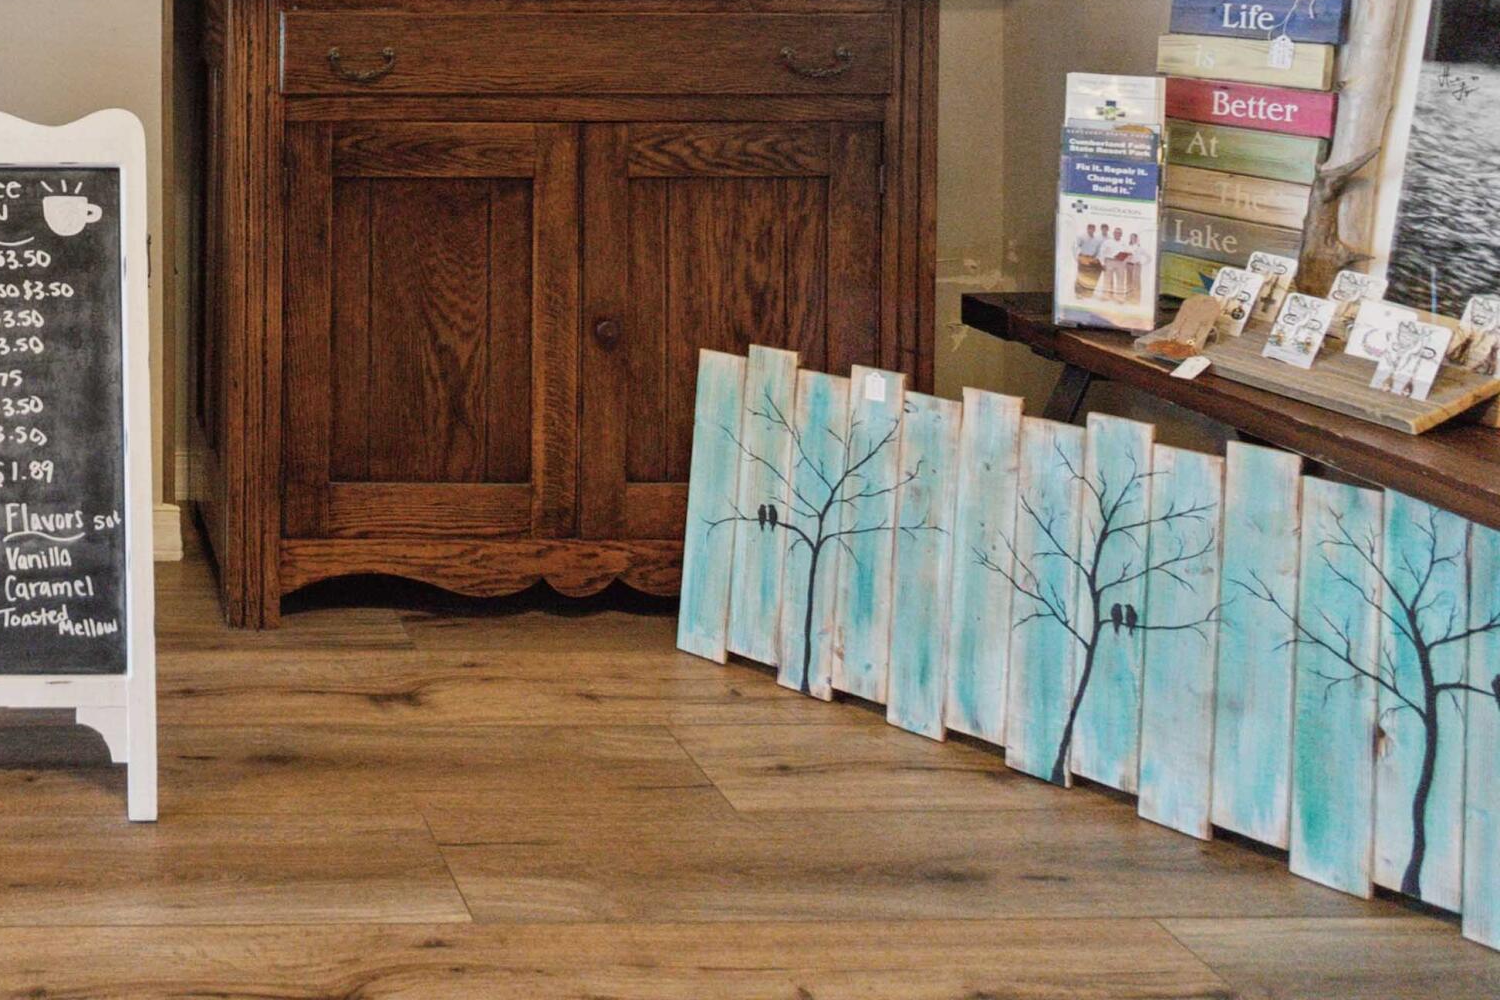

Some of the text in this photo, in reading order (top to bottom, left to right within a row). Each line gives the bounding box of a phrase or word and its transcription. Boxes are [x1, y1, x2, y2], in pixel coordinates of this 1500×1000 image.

[1222, 3, 1275, 30] Life
[1211, 91, 1299, 122] Better
[1068, 138, 1126, 149] Cumberland
[1068, 144, 1151, 157] State Resort Park
[1185, 131, 1220, 158] At
[1075, 162, 1092, 171] Fix
[1103, 165, 1136, 175] Repair
[1086, 173, 1124, 185] Change
[1092, 184, 1118, 193] Build
[1214, 180, 1269, 212] The
[1174, 219, 1238, 254] Lake
[22, 278, 75, 301] $3.50
[5, 503, 84, 533] Flavors
[6, 547, 73, 571] Vanilla
[4, 576, 95, 602] Caramel
[58, 618, 119, 638] Mellow
